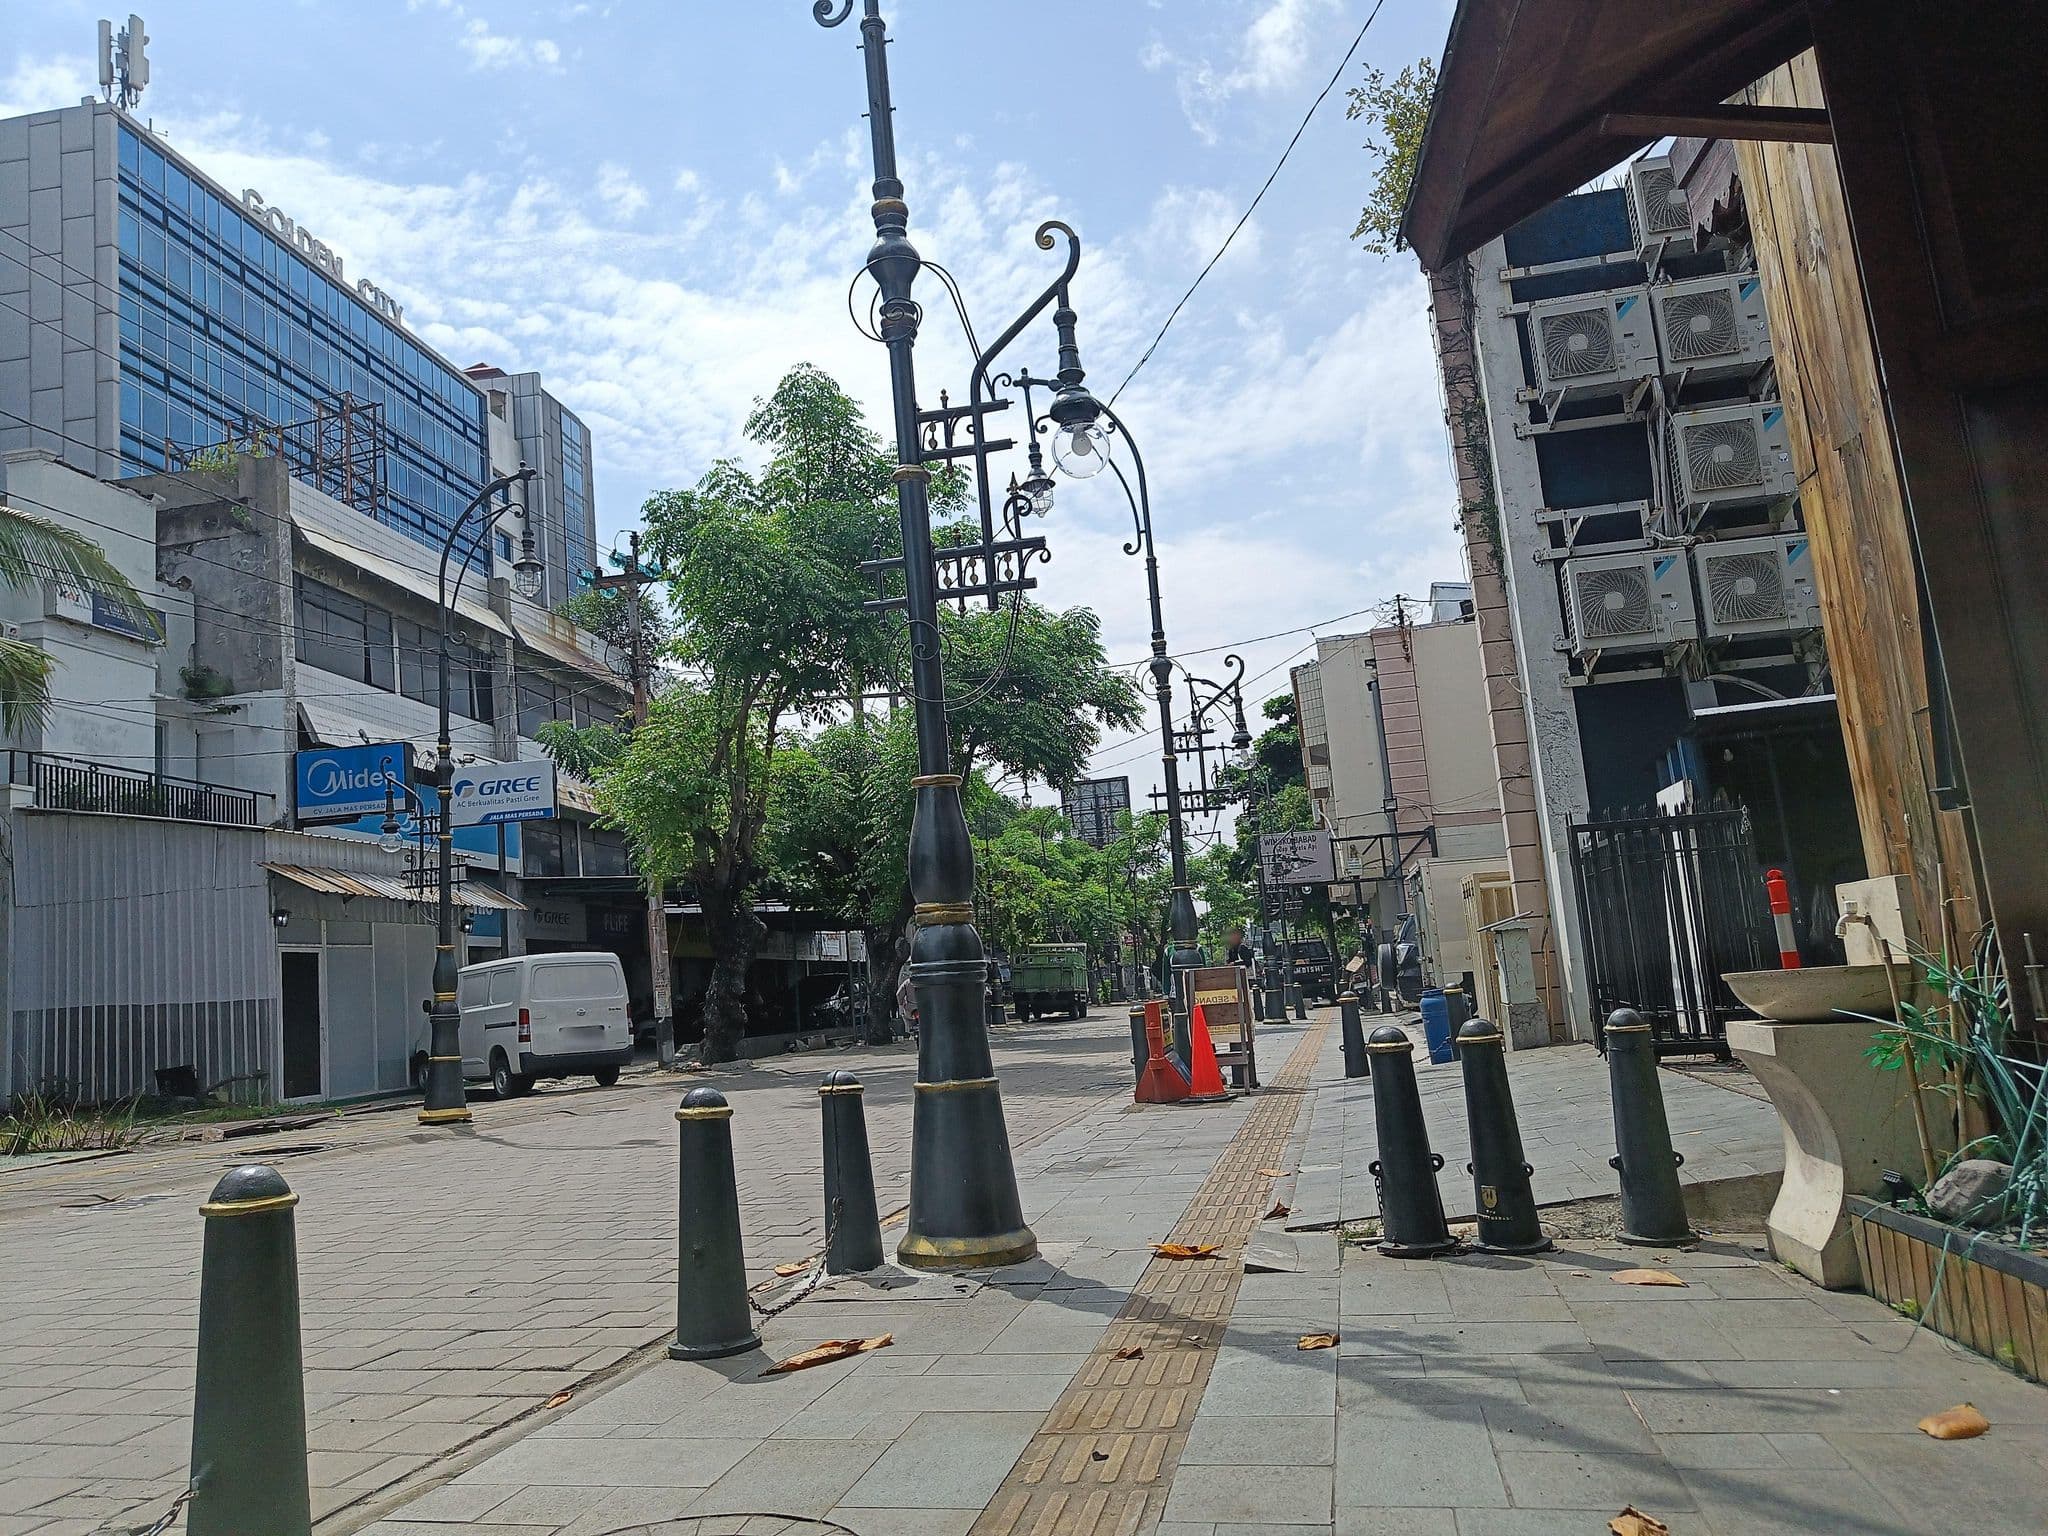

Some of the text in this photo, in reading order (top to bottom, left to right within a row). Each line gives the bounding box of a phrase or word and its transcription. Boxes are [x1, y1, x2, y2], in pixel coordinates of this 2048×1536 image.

[242, 188, 404, 325] GOLDEN CITY
[479, 776, 542, 796] GREE
[360, 802, 386, 810] PERSAD
[457, 800, 466, 808] AC
[467, 798, 505, 808] Berkualitas
[506, 796, 522, 804] Pasti
[518, 810, 544, 818] PERSADA
[544, 911, 570, 925] GREE
